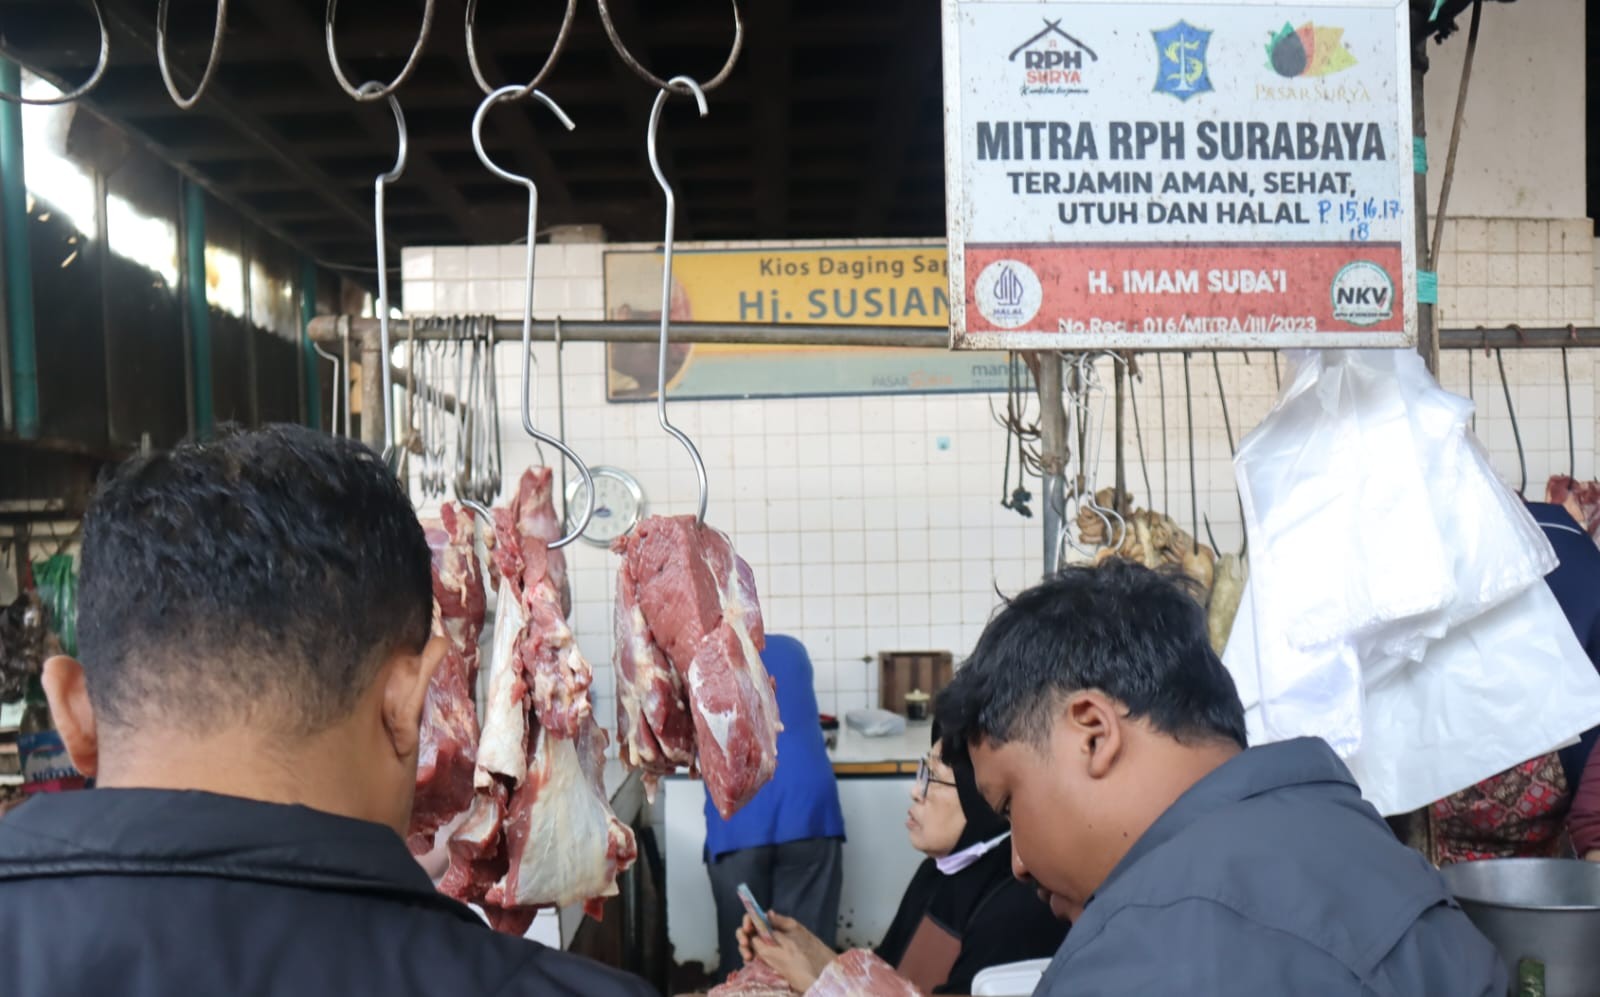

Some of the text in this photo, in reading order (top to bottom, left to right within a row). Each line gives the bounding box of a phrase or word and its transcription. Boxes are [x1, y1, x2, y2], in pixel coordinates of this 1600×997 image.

[1025, 51, 1082, 69] RPH
[1026, 70, 1081, 84] SURYA
[977, 121, 1386, 161] MITRA RPH SURABAYA
[1007, 171, 1356, 198] TERJAMIN AMAN, SEHAT,
[1058, 202, 1310, 225] UTUH DAN HALAL
[760, 258, 810, 277] Kios
[818, 255, 904, 279] Daging
[1088, 270, 1113, 294] H.
[1122, 269, 1199, 293] IMAM
[739, 289, 793, 323] Hj.
[1336, 287, 1389, 308] NKV
